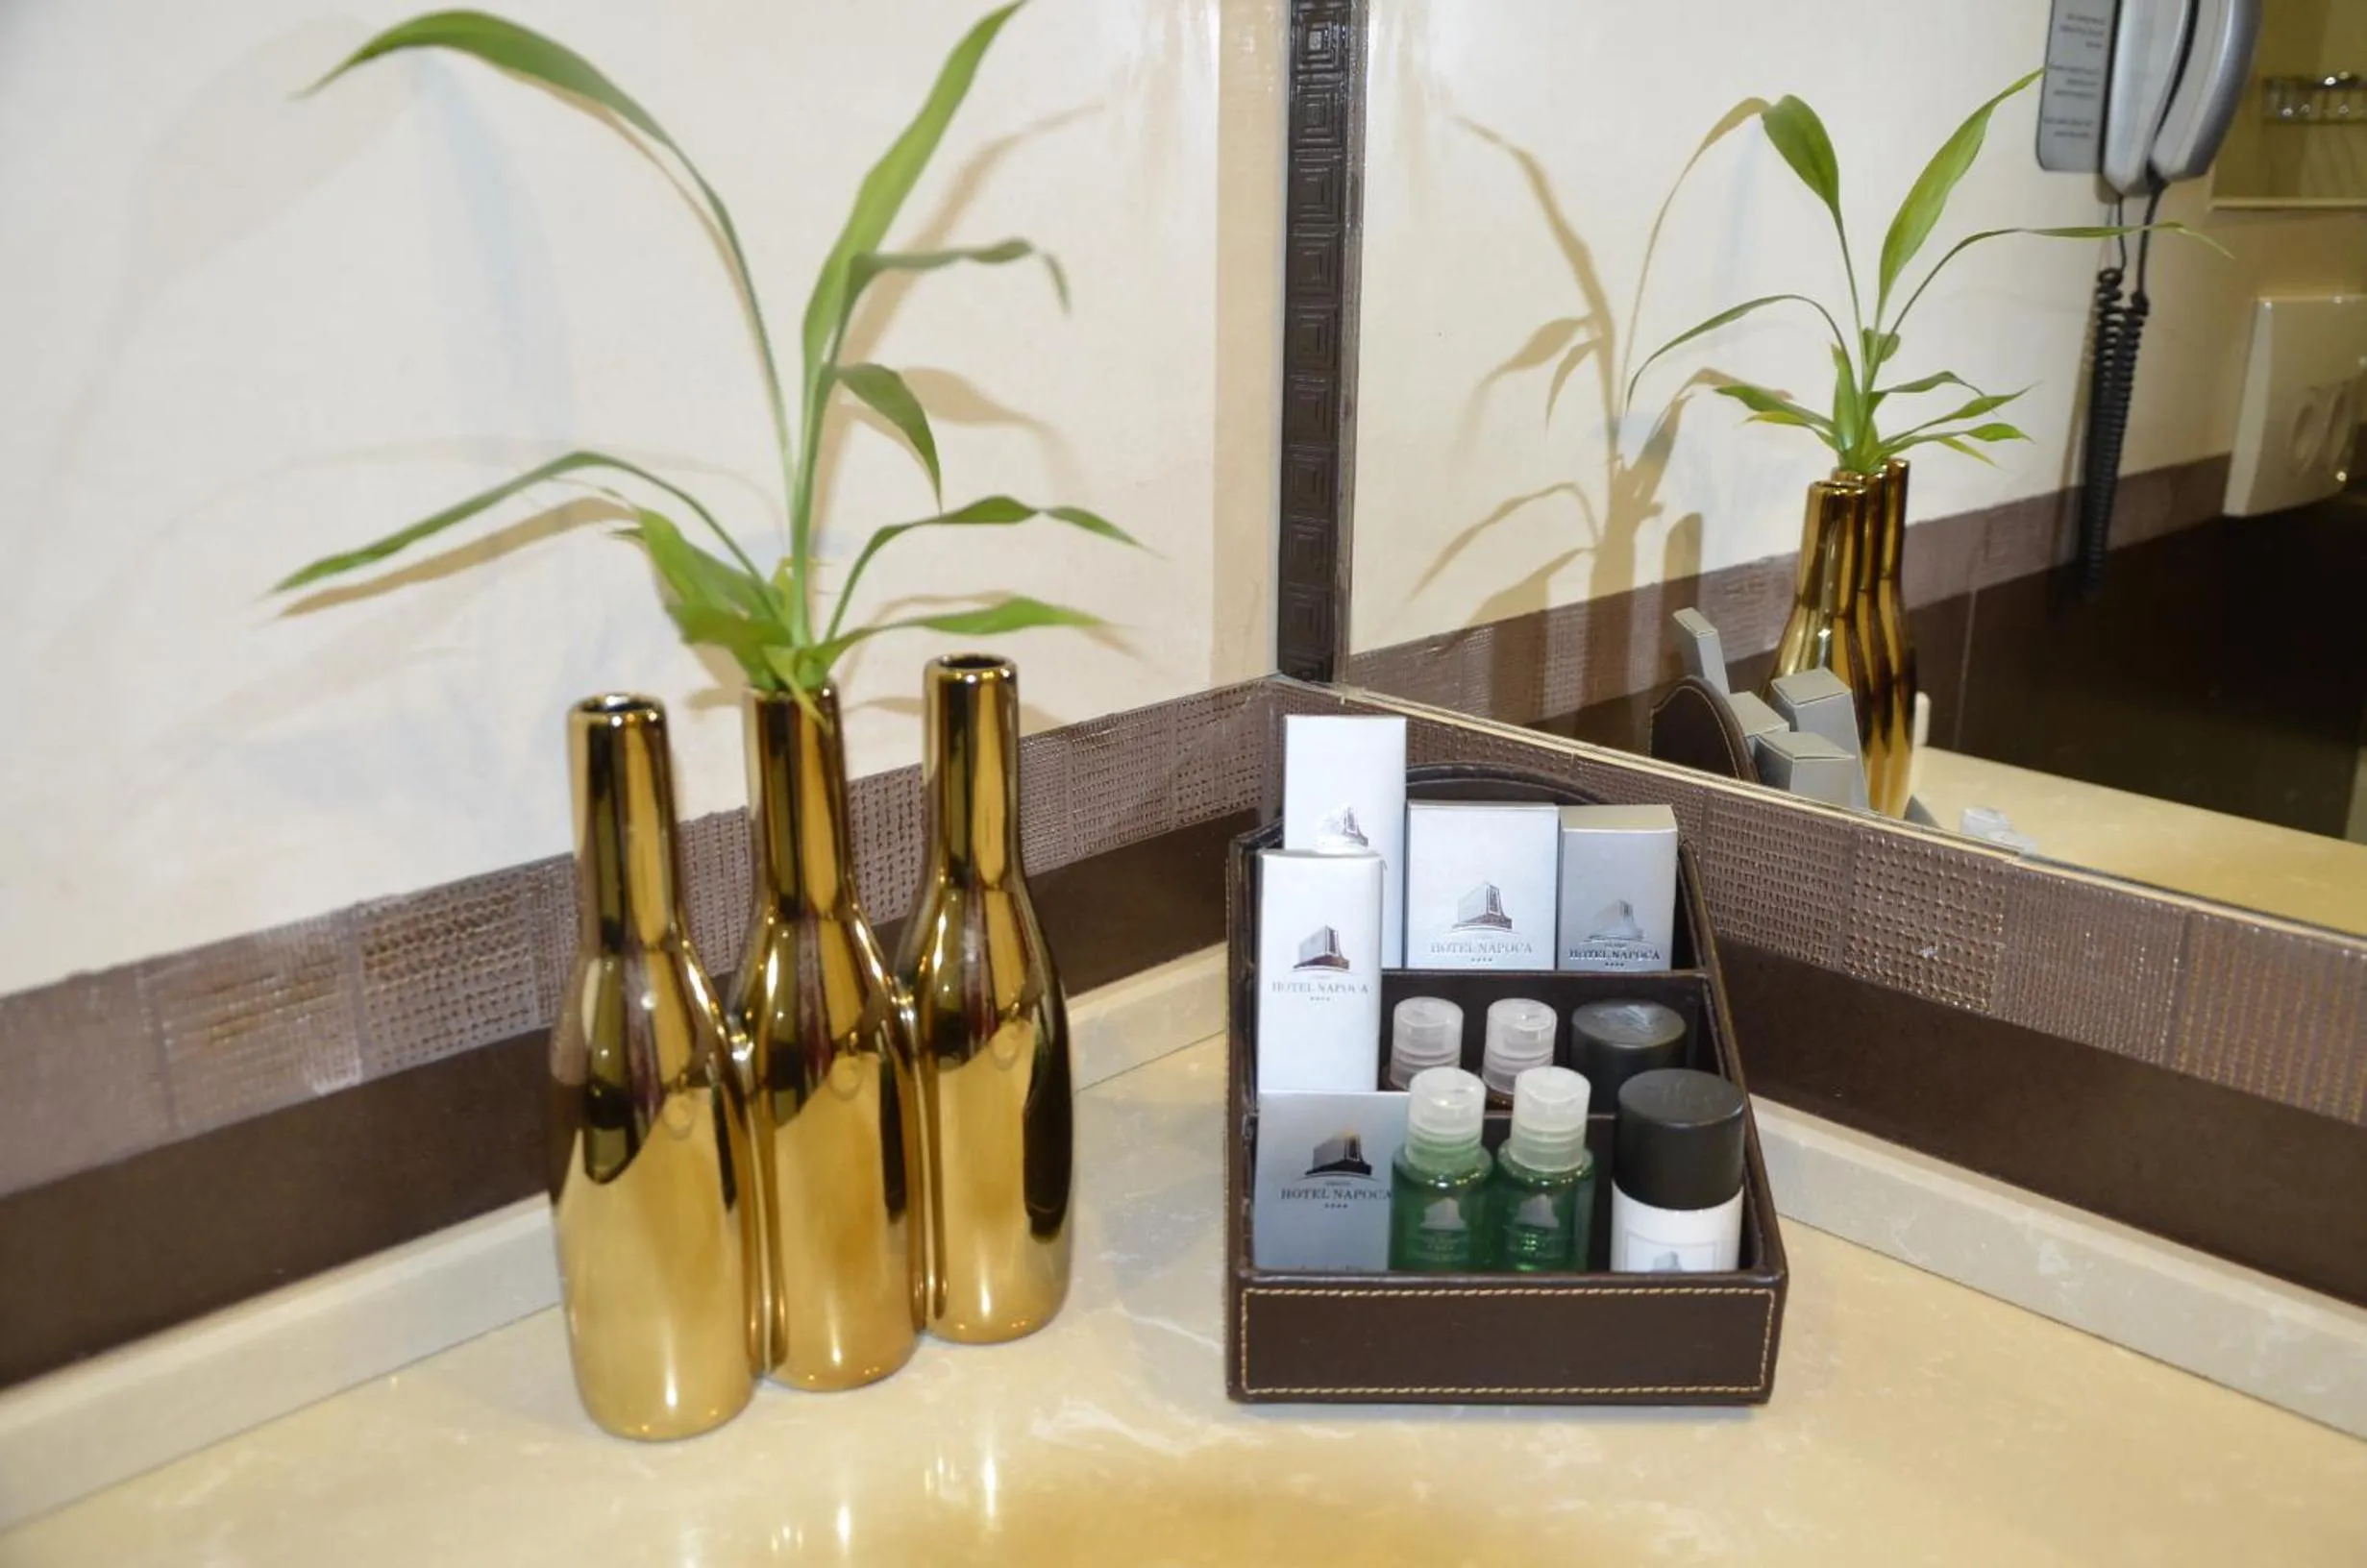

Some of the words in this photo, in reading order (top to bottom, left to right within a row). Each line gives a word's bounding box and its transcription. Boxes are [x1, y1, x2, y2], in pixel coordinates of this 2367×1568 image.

[1569, 947, 1607, 959] HOTEL
[1612, 947, 1661, 960] NAPOCA
[1280, 1188, 1330, 1200] HOTEL
